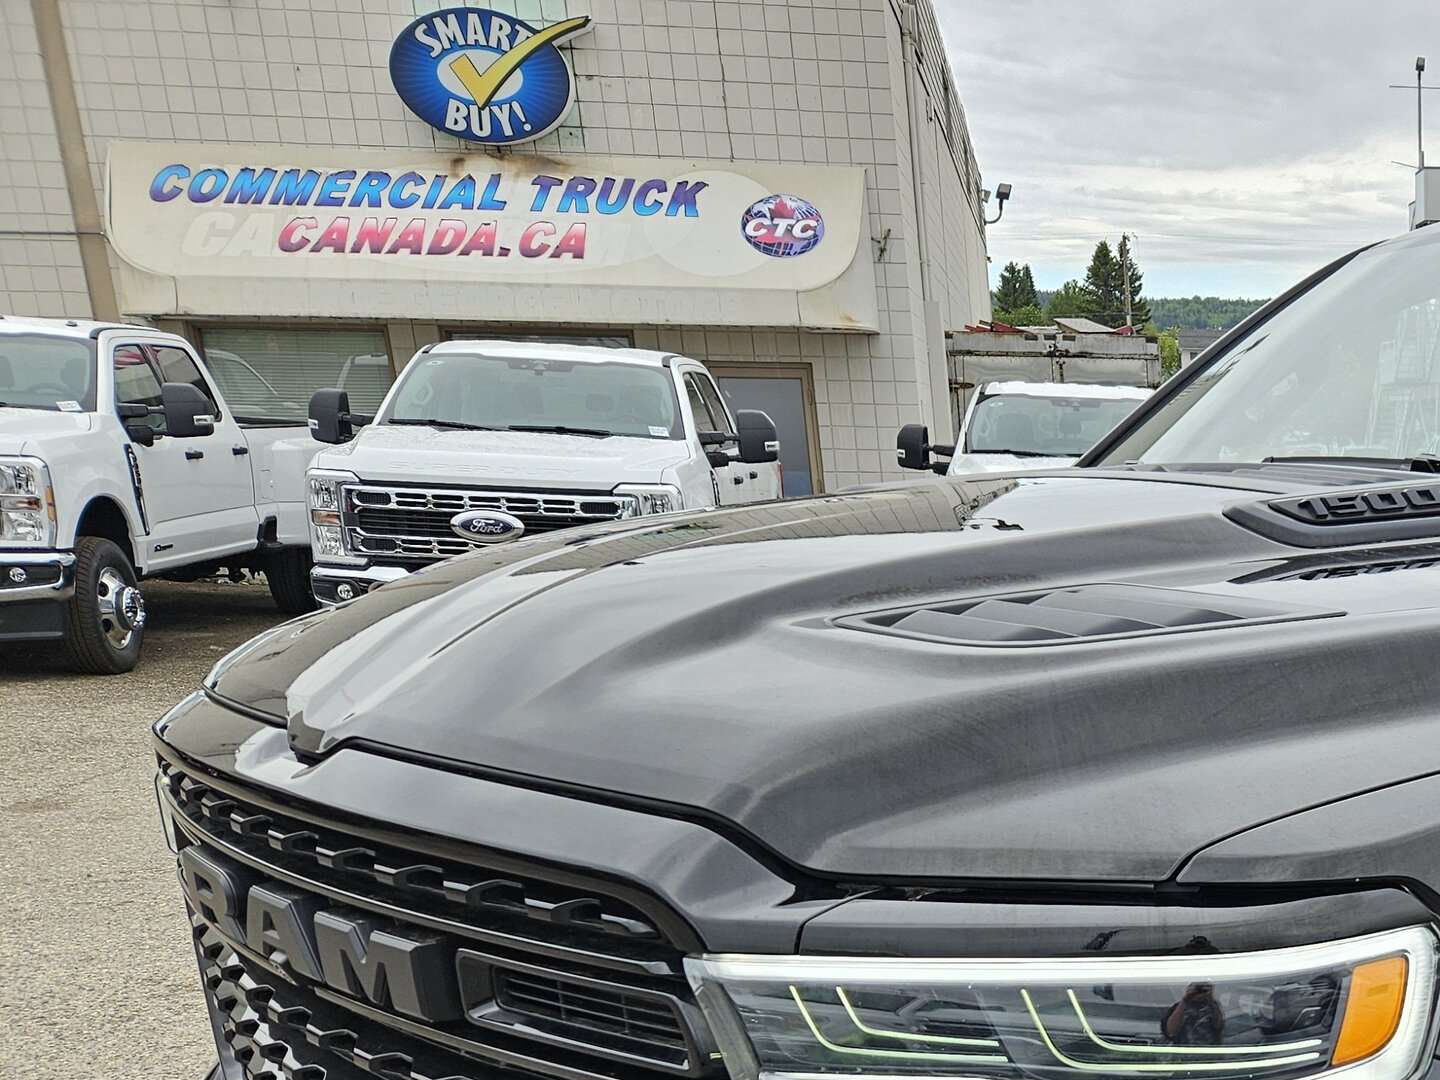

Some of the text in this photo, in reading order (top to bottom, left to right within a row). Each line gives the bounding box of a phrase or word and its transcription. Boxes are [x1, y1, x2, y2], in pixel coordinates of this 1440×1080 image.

[414, 12, 534, 59] SMART
[444, 98, 532, 138] BUY!
[148, 162, 710, 218] COMMERCIAL TRUCK
[276, 215, 588, 260] CANADA.CA
[744, 216, 820, 240] CTC
[470, 518, 504, 533] Ford
[178, 846, 444, 1023] RAM
